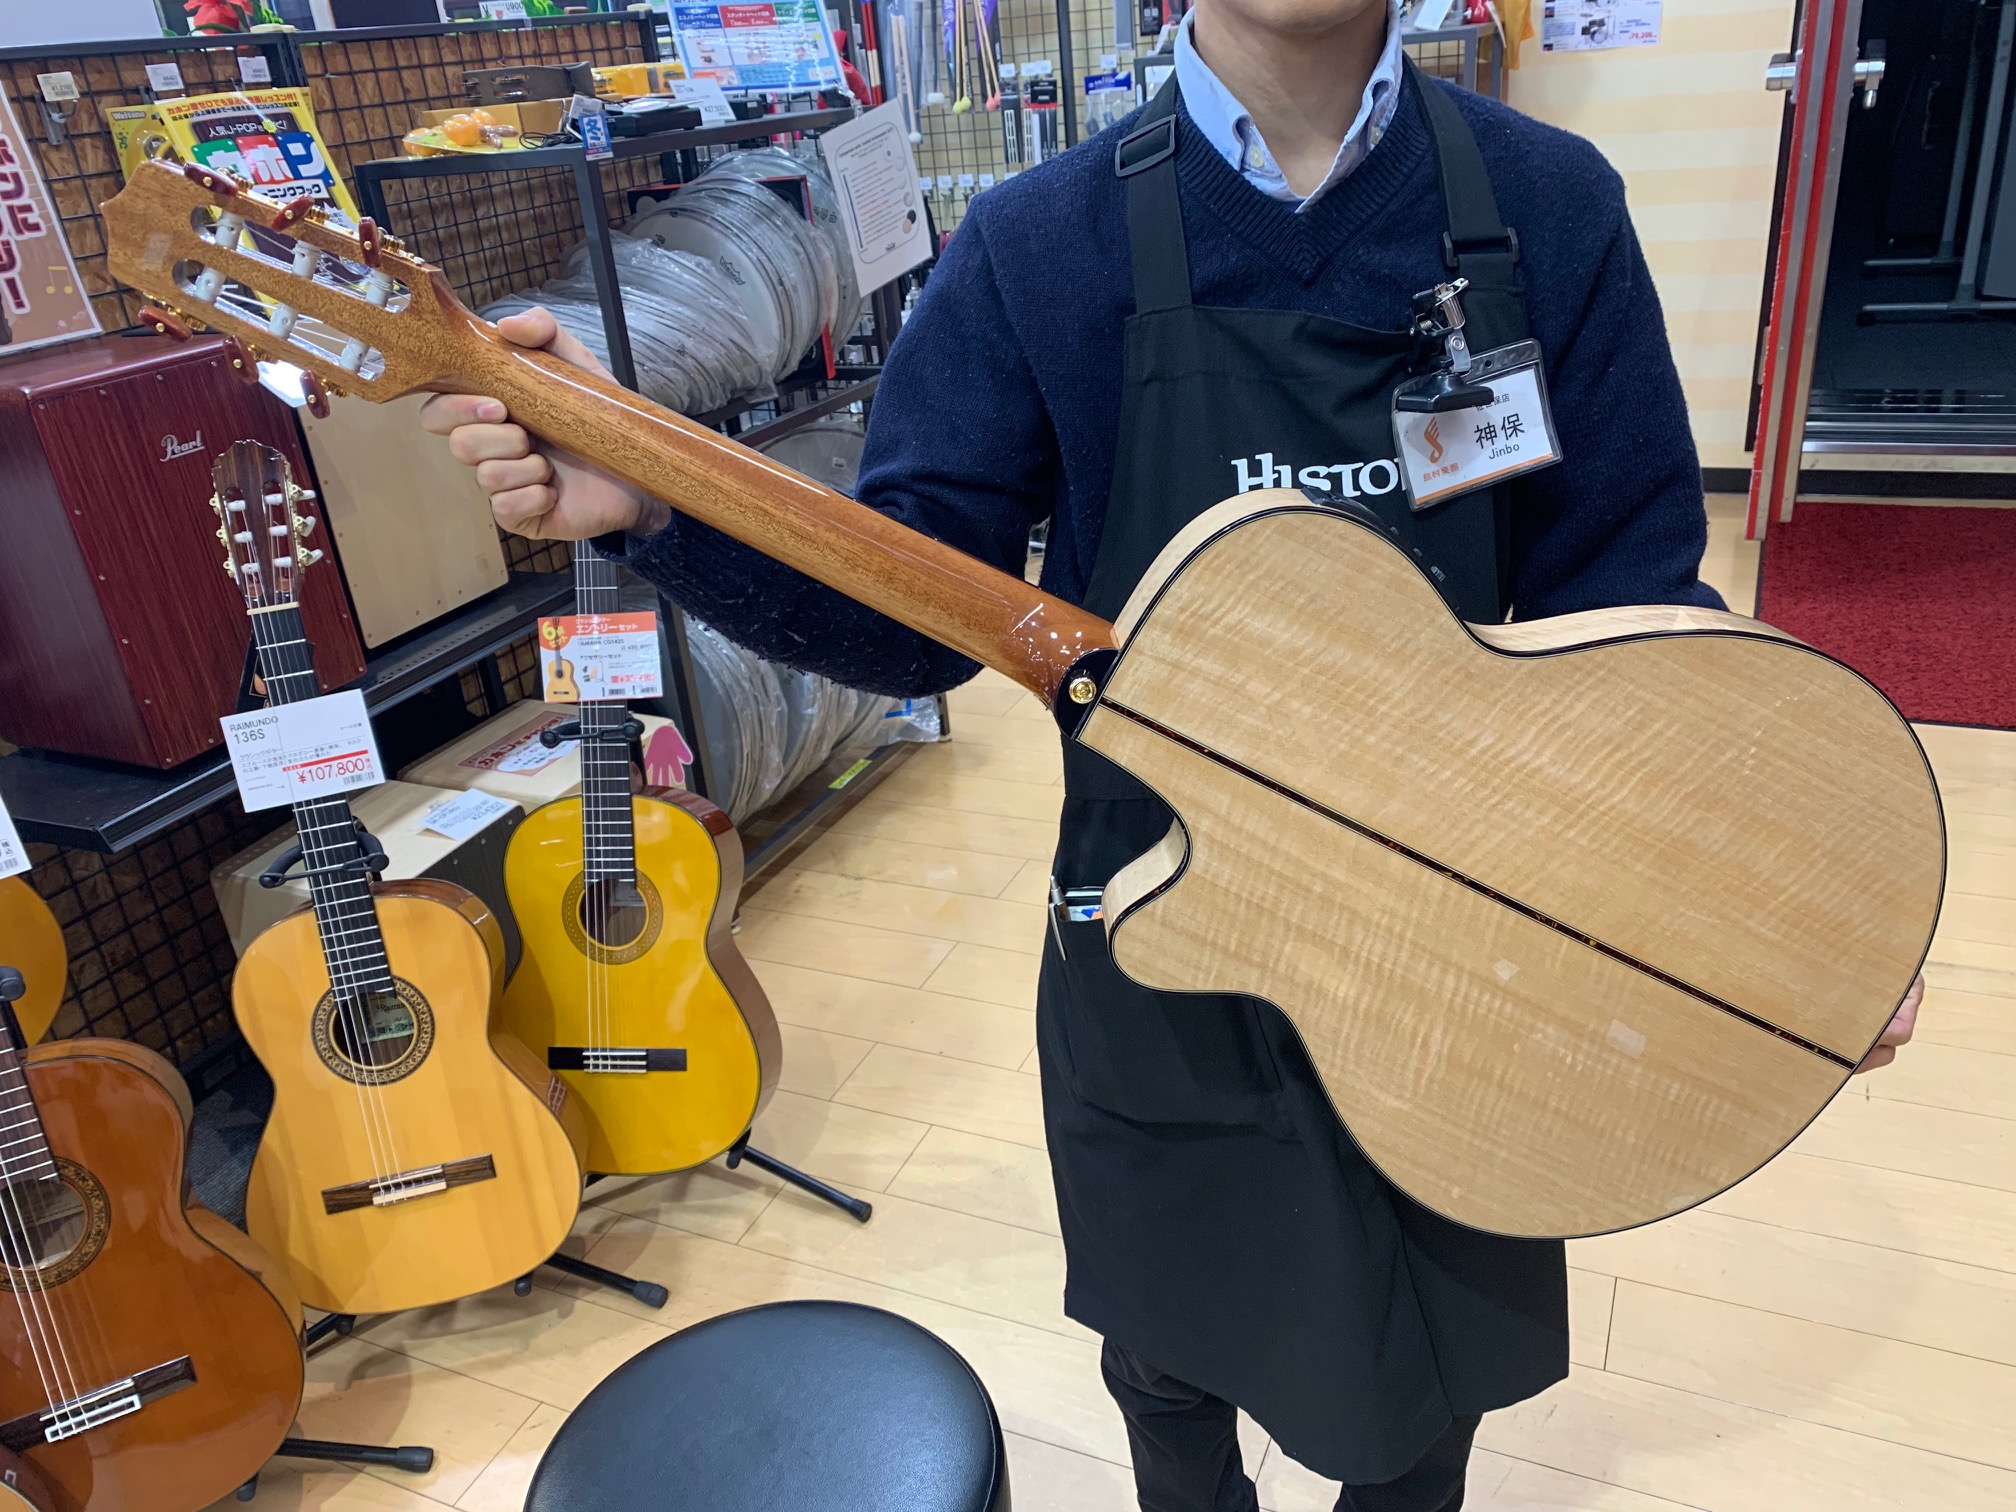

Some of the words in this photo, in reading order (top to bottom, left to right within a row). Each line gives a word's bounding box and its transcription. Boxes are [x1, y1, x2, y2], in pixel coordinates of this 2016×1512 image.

[1474, 413, 1525, 449] 神保
[160, 430, 201, 461] Pearl
[1489, 443, 1520, 460] Jinbo
[1231, 452, 1406, 497] HISTO
[229, 716, 278, 733] RAIMUNDO
[233, 729, 266, 744] 136S
[296, 758, 365, 784] ¥107,800
